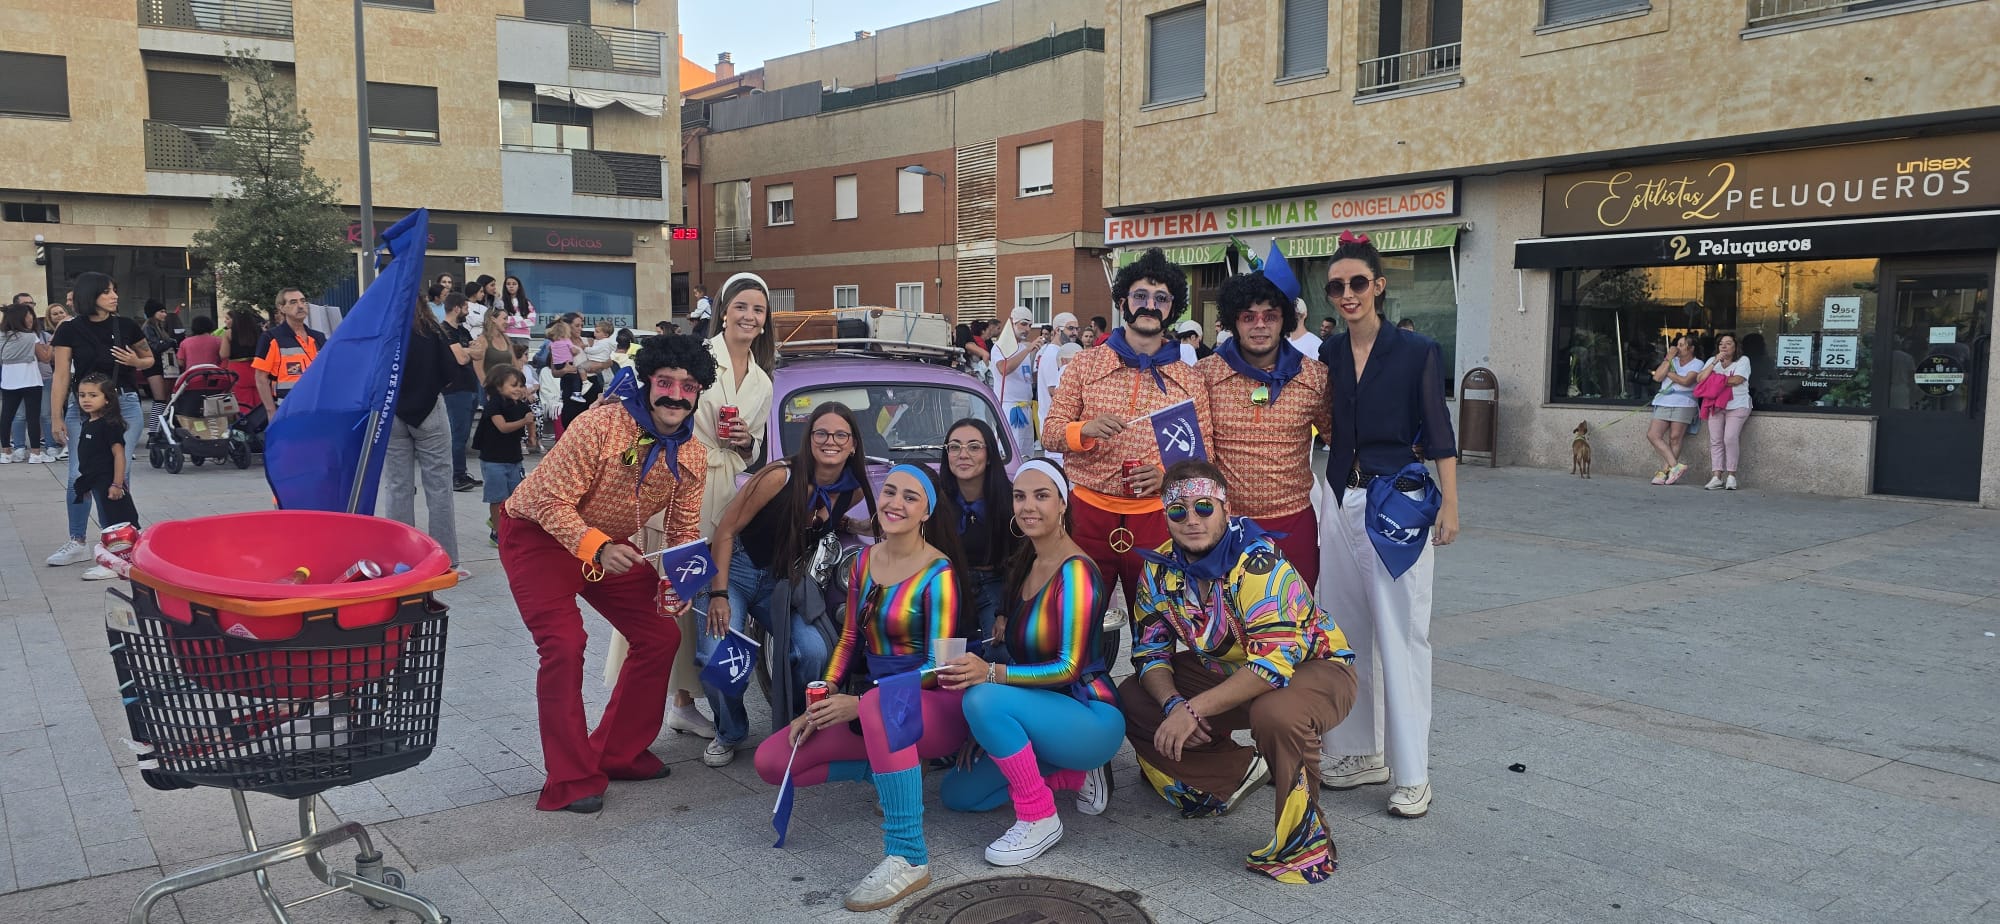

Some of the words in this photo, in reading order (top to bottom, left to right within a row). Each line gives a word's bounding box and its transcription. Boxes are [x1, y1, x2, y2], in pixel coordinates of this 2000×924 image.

[1896, 156, 1972, 174] unisex
[1565, 171, 1704, 227] Estilistas
[1681, 162, 1735, 220] 2
[1726, 170, 1970, 211] PELUQUEROS
[1108, 208, 1219, 241] FRUTERÍA
[1226, 199, 1319, 230] SILMAR
[1331, 191, 1446, 219] CONGELADOS
[1288, 234, 1344, 256] FRUTE
[1375, 228, 1433, 250] SILMAR
[1669, 235, 1691, 261] 2
[1698, 237, 1812, 257] Peluqueros
[1133, 245, 1210, 264] CELADOS
[1825, 354, 1851, 366] 25€
[1801, 380, 1828, 388] Unisex
